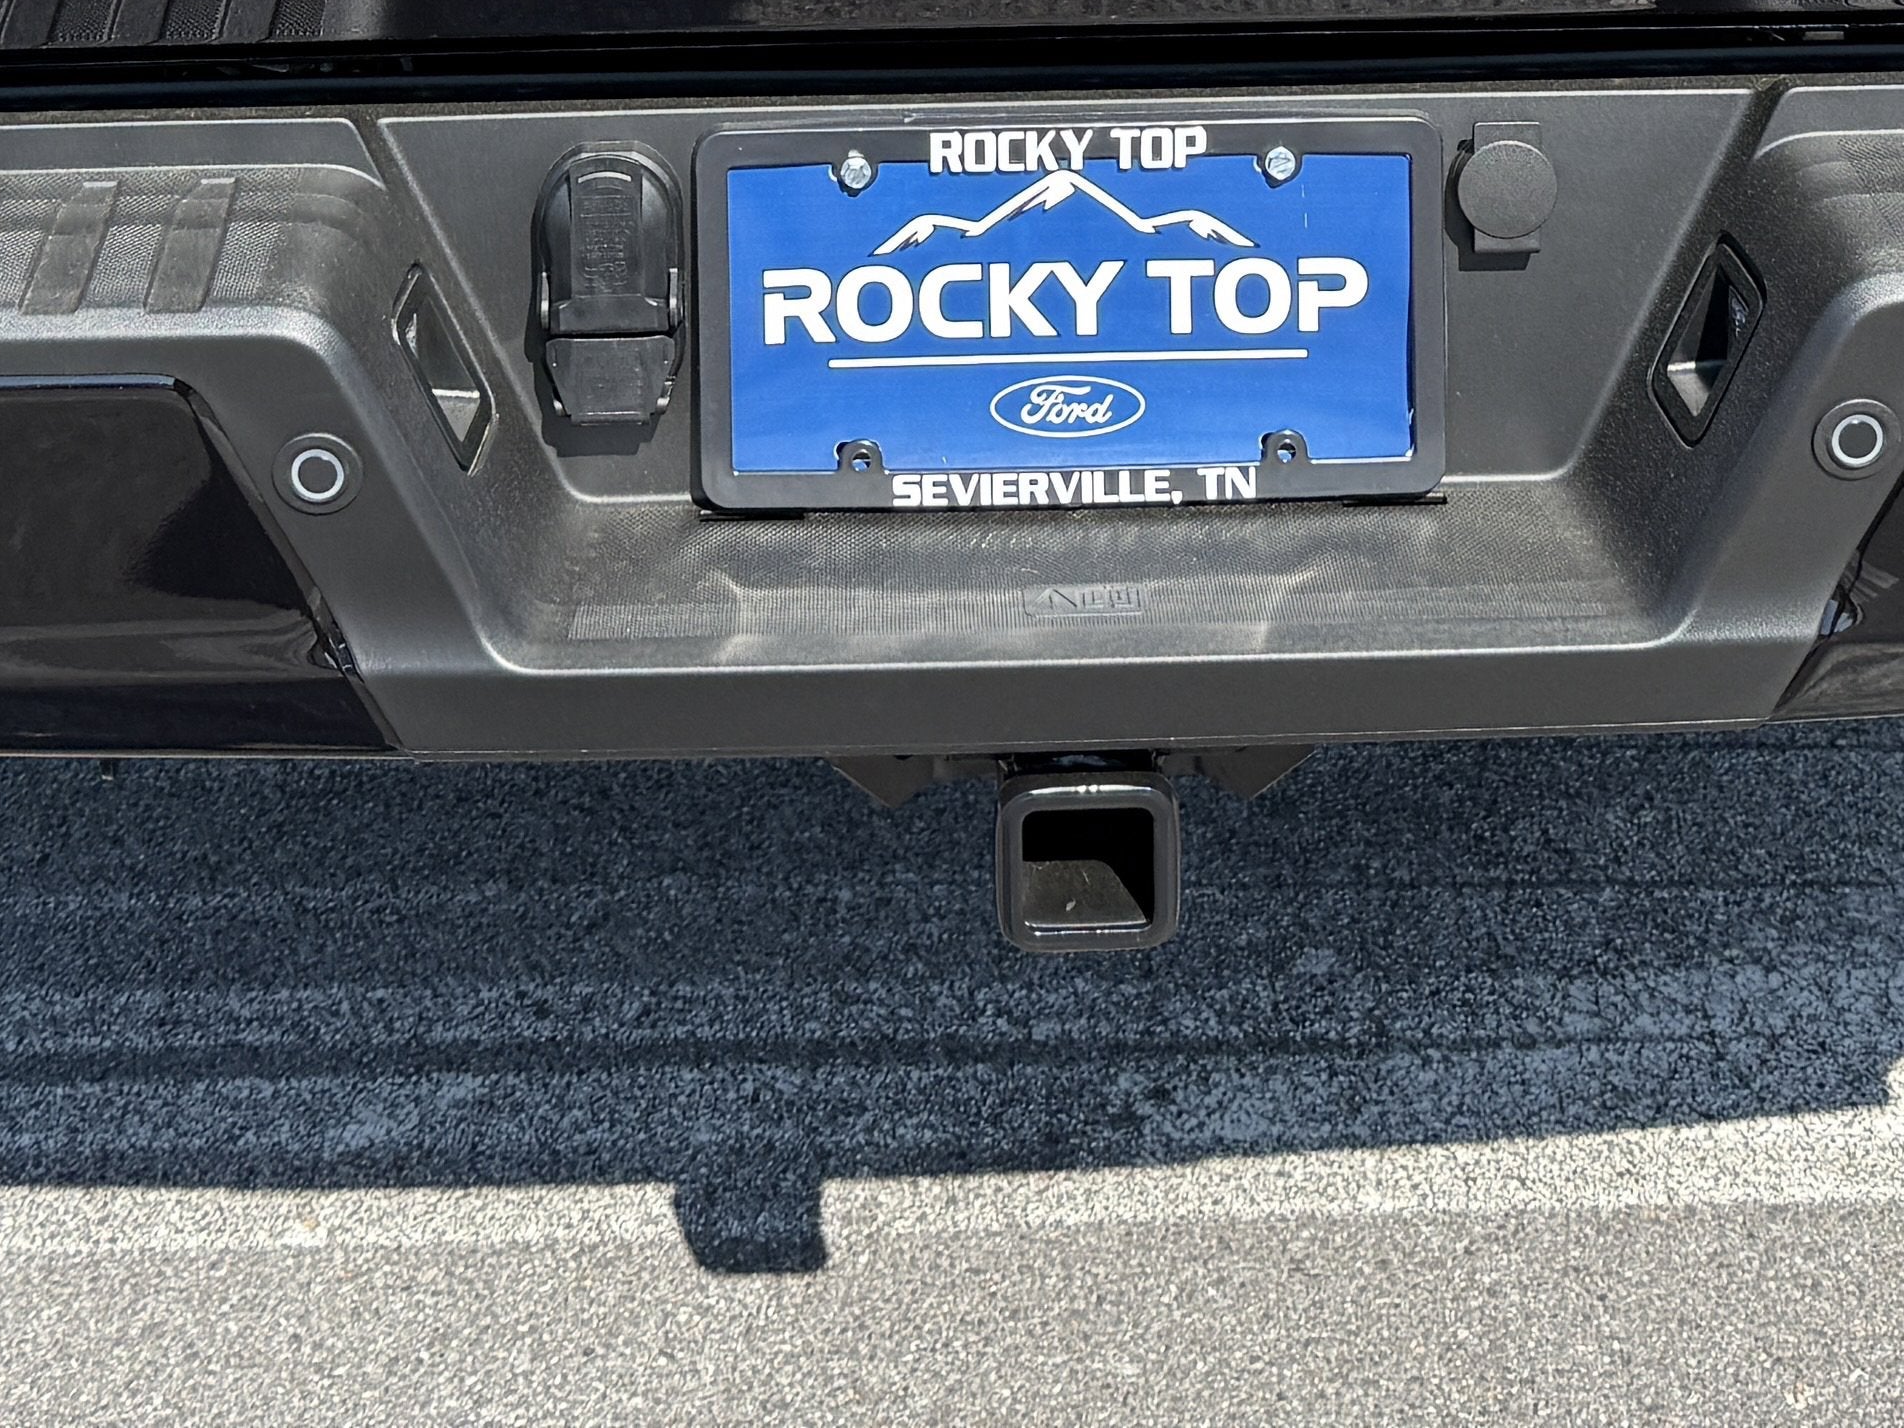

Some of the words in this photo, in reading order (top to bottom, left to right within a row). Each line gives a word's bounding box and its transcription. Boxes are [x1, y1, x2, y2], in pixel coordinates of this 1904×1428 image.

[928, 128, 1095, 175] ROCKY
[1110, 125, 1208, 171] TOP
[761, 259, 1128, 346] ROCKY
[1145, 256, 1371, 336] TOP
[1019, 380, 1116, 426] Ford
[891, 469, 1183, 508] SEVIERVILLE,
[1195, 466, 1258, 501] TN
